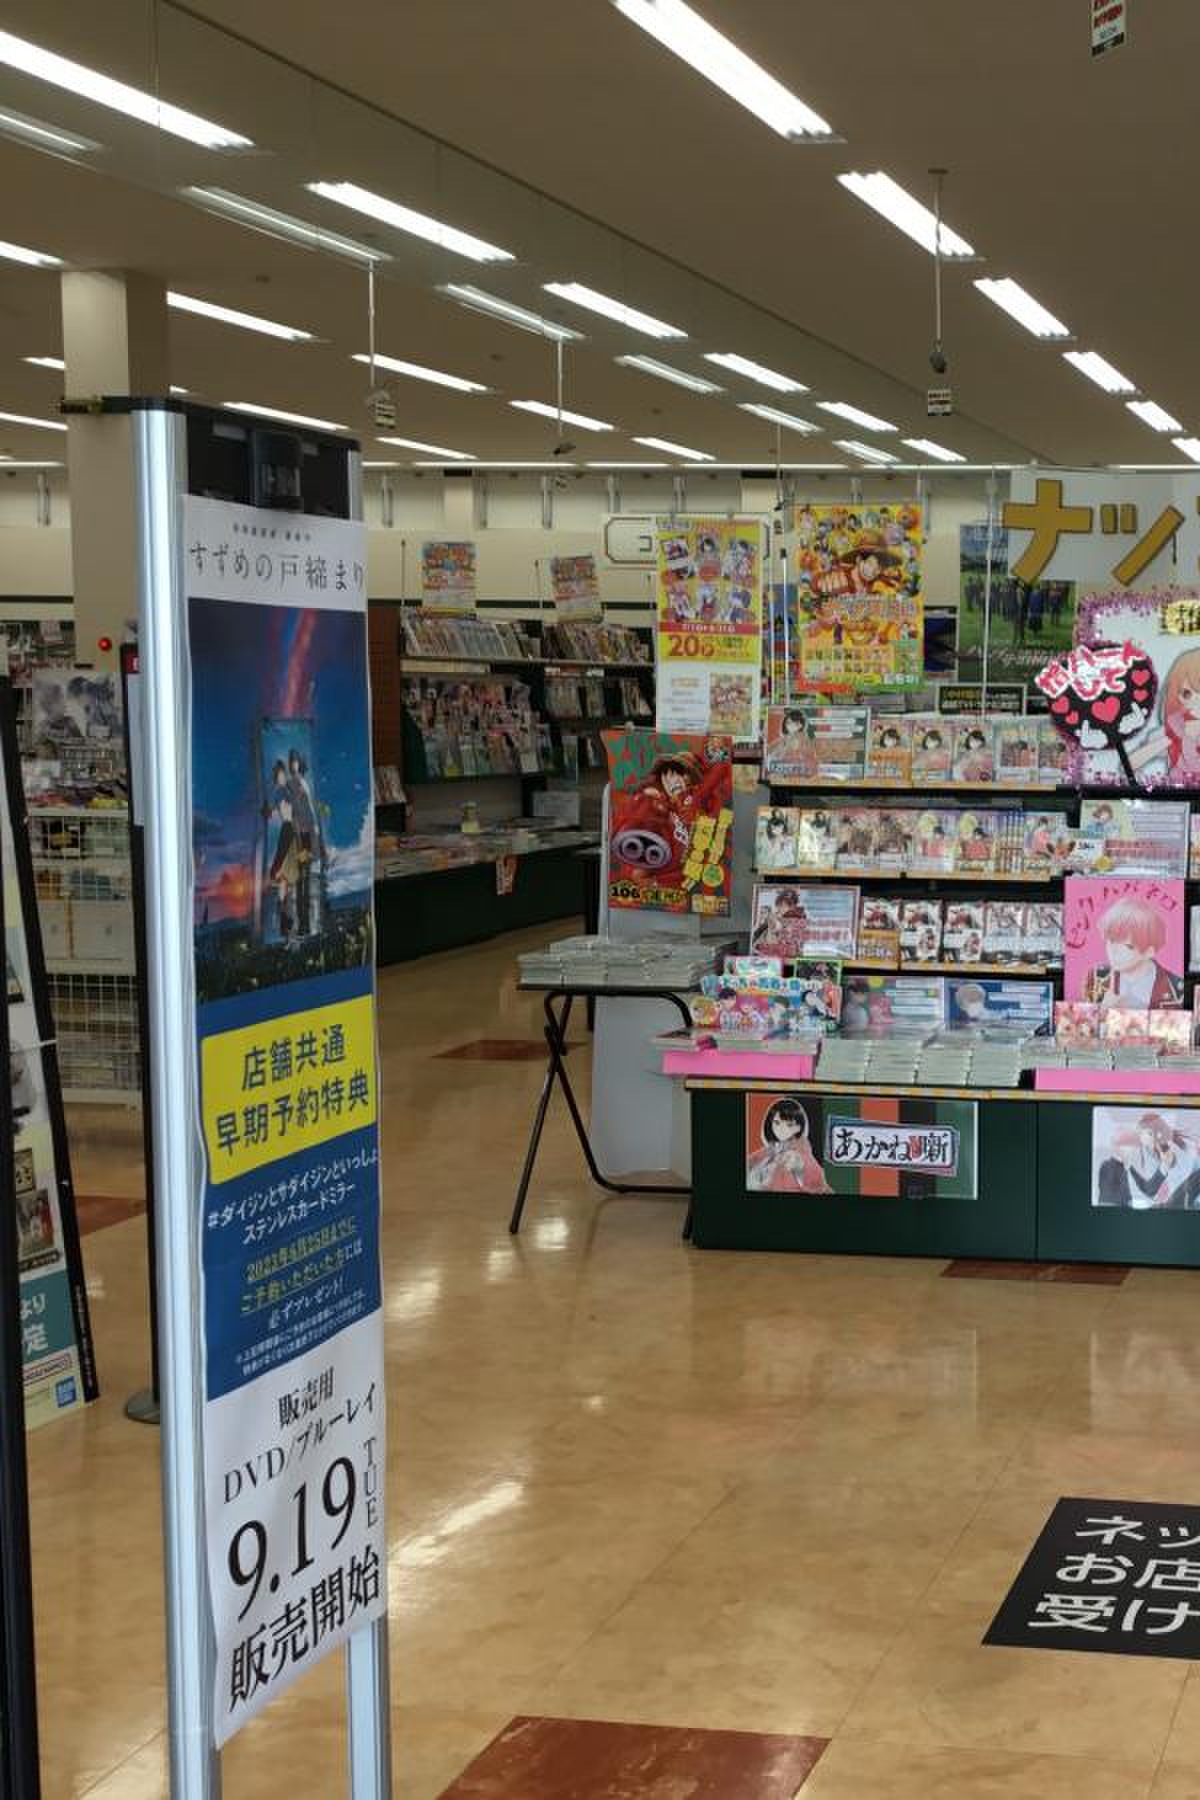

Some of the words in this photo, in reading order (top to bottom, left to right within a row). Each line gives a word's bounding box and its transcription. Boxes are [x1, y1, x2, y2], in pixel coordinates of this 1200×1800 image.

[189, 541, 365, 594] すずめの戸締まり
[241, 1023, 346, 1091] 店舗共通
[216, 1067, 369, 1157] 早期予約特典
[835, 1128, 949, 1163] あかね噺
[278, 1365, 334, 1427] 販売用
[223, 1382, 377, 1505] DVD/ブルーレイ
[362, 1437, 378, 1528] TUE
[227, 1457, 357, 1623] 9.19
[229, 1545, 379, 1713] 販売開始
